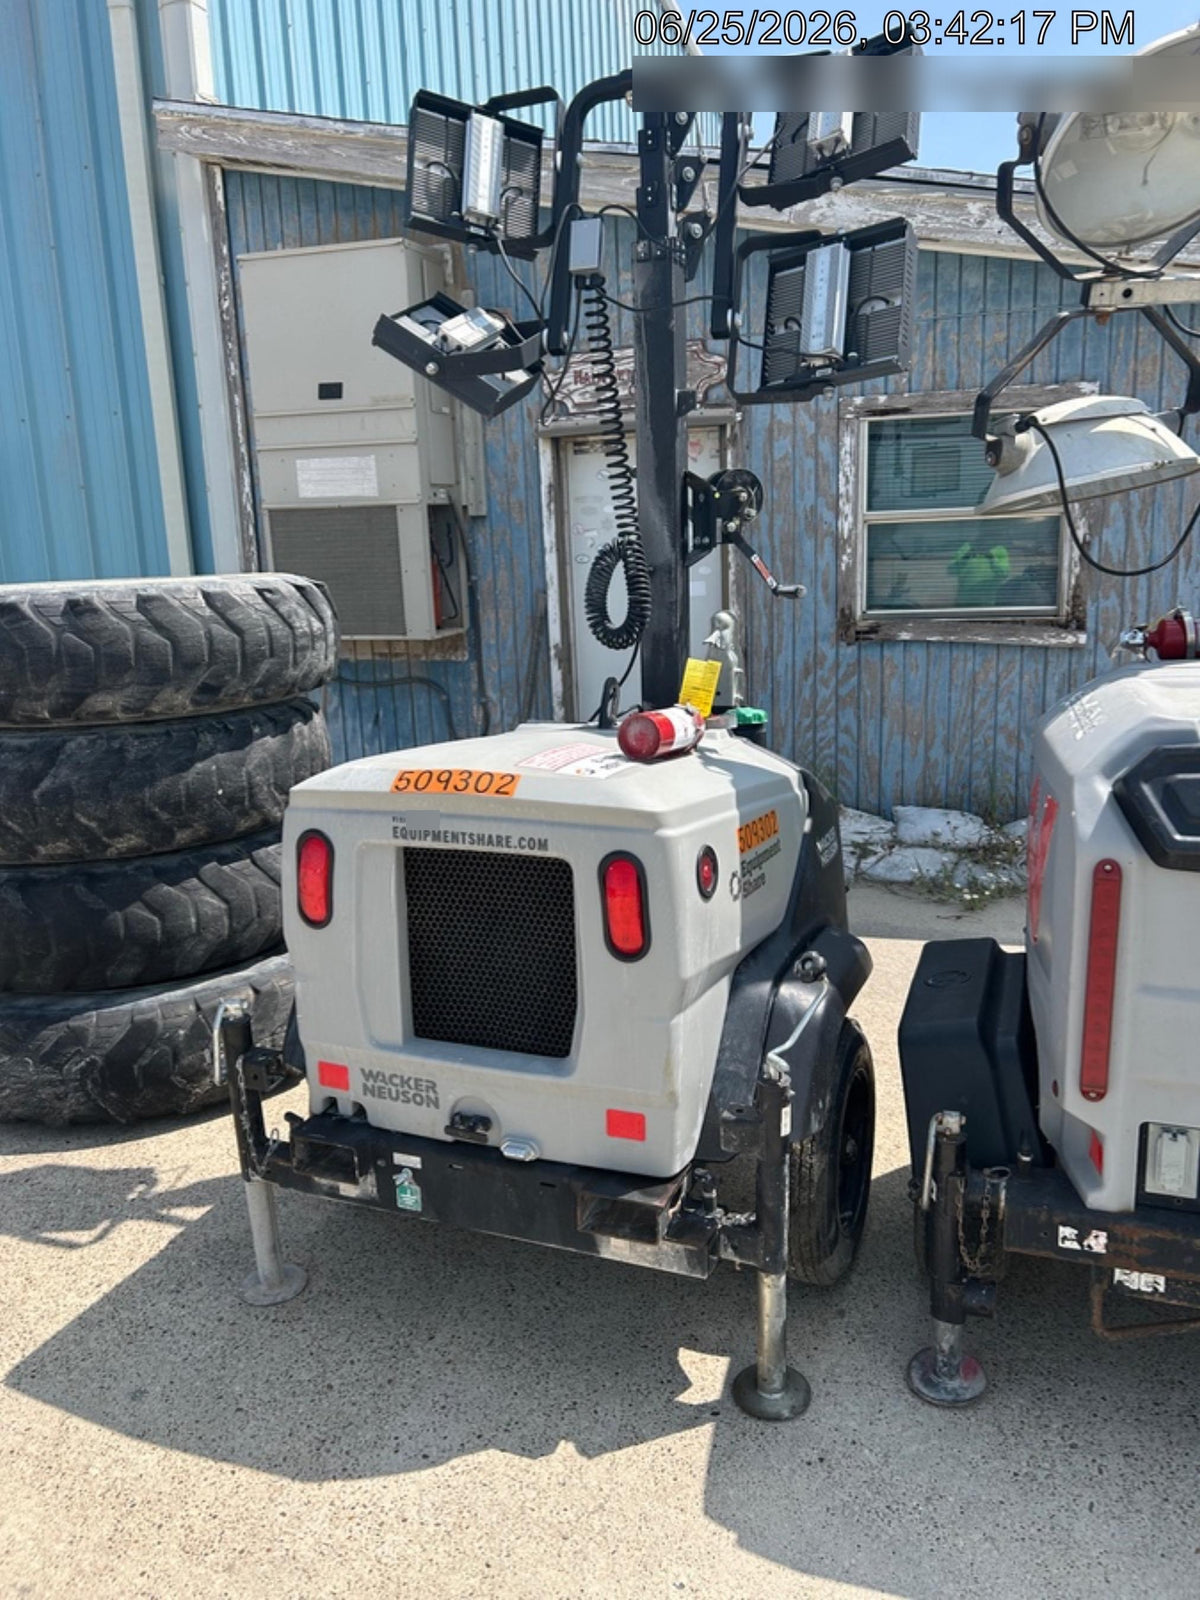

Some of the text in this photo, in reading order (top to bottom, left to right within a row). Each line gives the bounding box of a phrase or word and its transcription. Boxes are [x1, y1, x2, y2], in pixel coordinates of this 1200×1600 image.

[394, 769, 516, 795] 509302
[392, 826, 549, 852] EQUIPMENTSHARE.COM
[738, 809, 778, 854] 509302
[360, 1067, 438, 1094] WACKER
[362, 1083, 440, 1110] NEUSON
